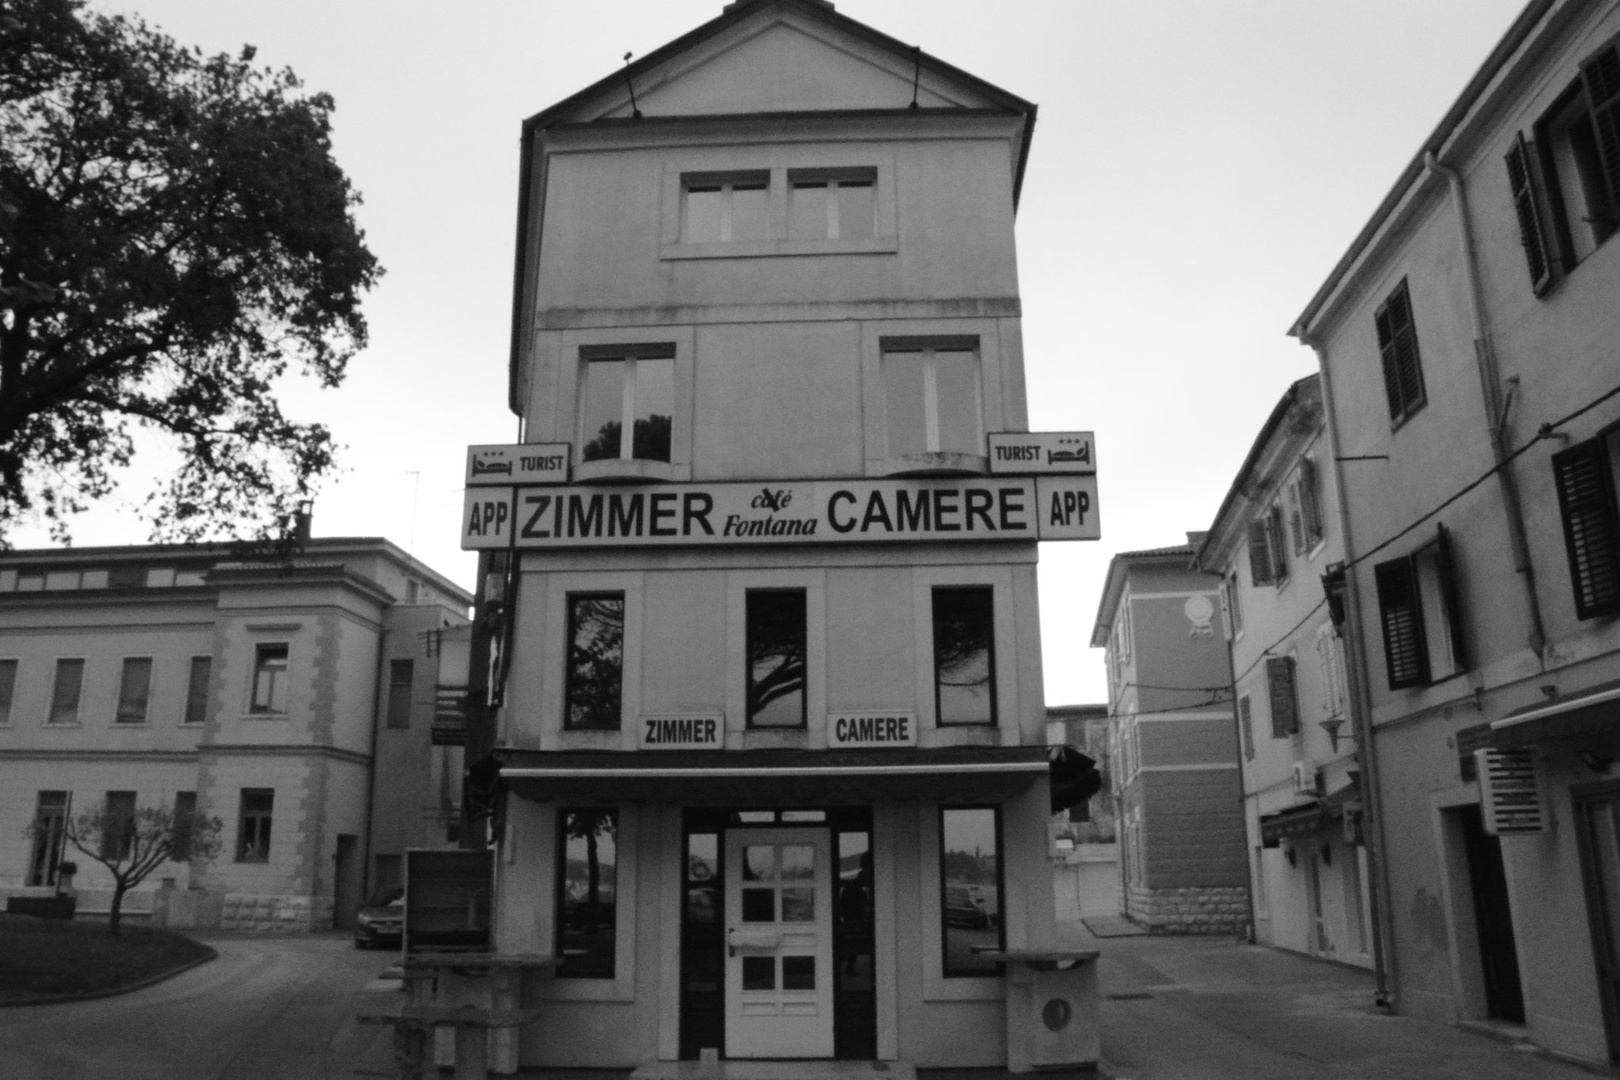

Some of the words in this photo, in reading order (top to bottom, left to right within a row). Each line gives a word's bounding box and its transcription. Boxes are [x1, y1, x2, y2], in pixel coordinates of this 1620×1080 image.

[520, 455, 564, 471] TURIST
[995, 445, 1041, 461] TURIST
[467, 501, 508, 536] APP
[520, 492, 715, 539] ZIMMER
[827, 487, 1027, 533] CAMERE
[1050, 491, 1090, 526] APP
[723, 514, 818, 537] Fontana
[645, 719, 717, 743] ZIMMER
[836, 717, 909, 742] CAMERE
